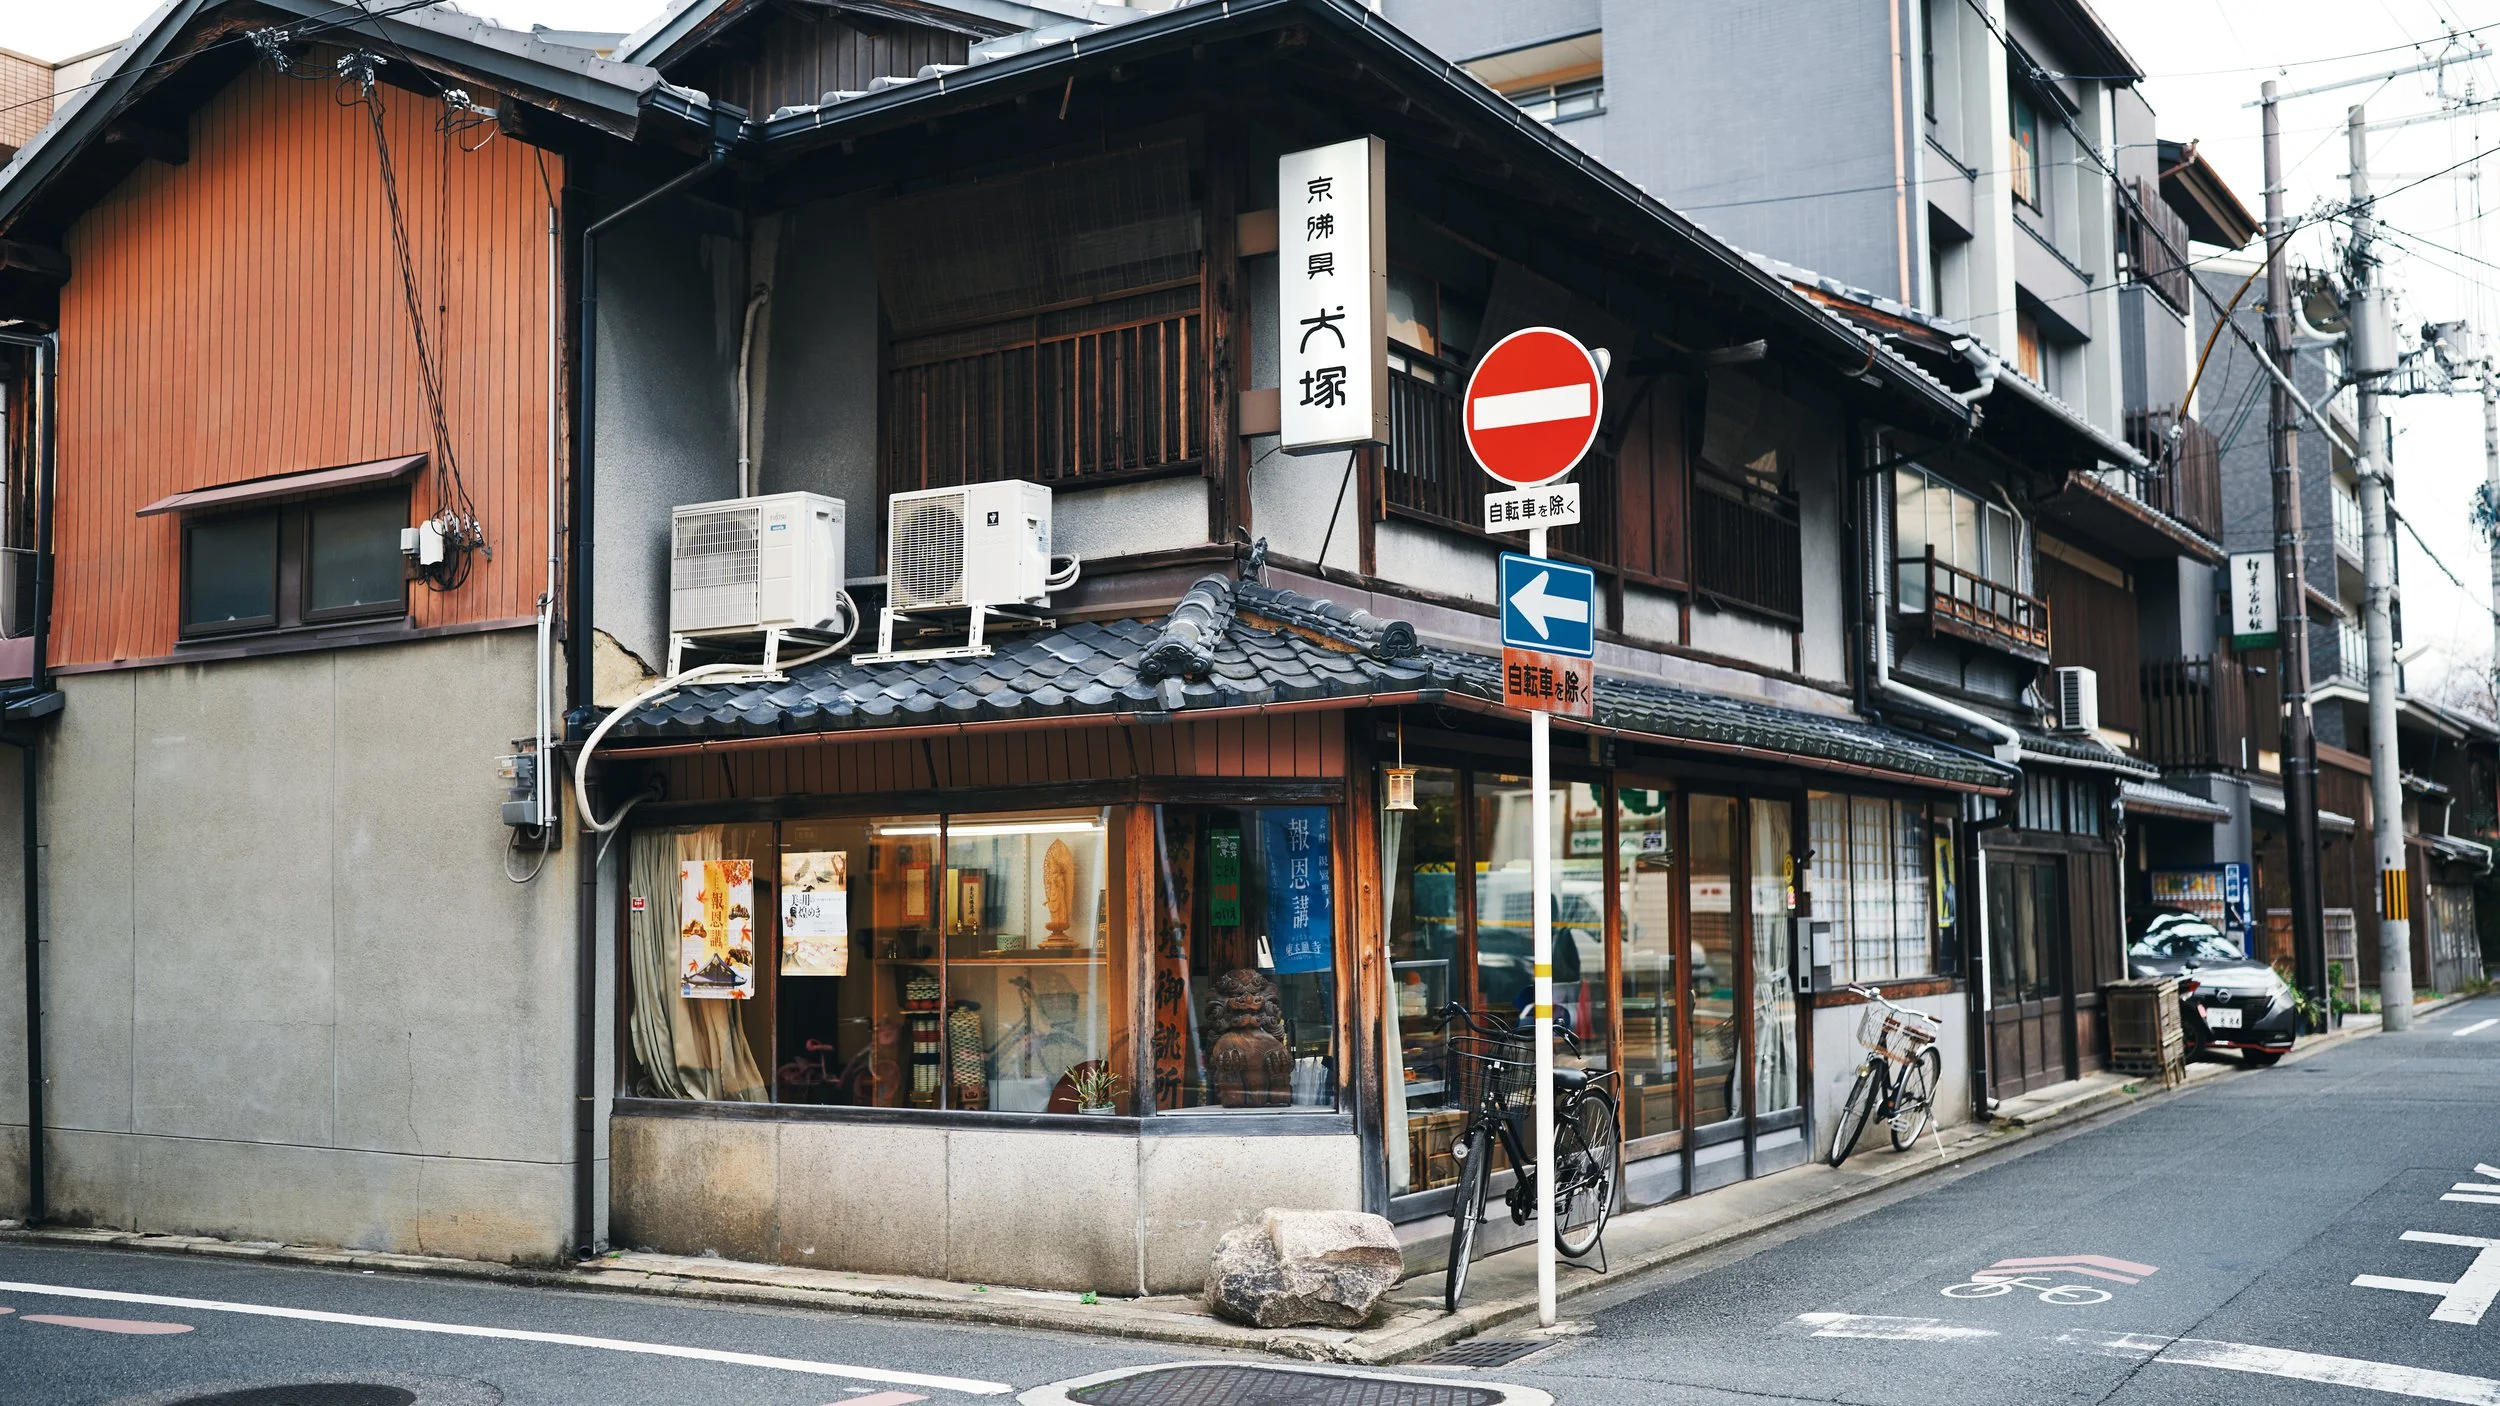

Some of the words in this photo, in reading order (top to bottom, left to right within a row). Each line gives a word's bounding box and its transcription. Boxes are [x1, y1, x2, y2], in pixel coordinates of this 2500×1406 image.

[1307, 176, 1334, 280] 京佛具
[1299, 305, 1346, 409] 犬塚
[1489, 494, 1576, 523] 自転車を除く
[1508, 662, 1589, 704] 自転車を除く
[1288, 818, 1310, 929] 報恩講
